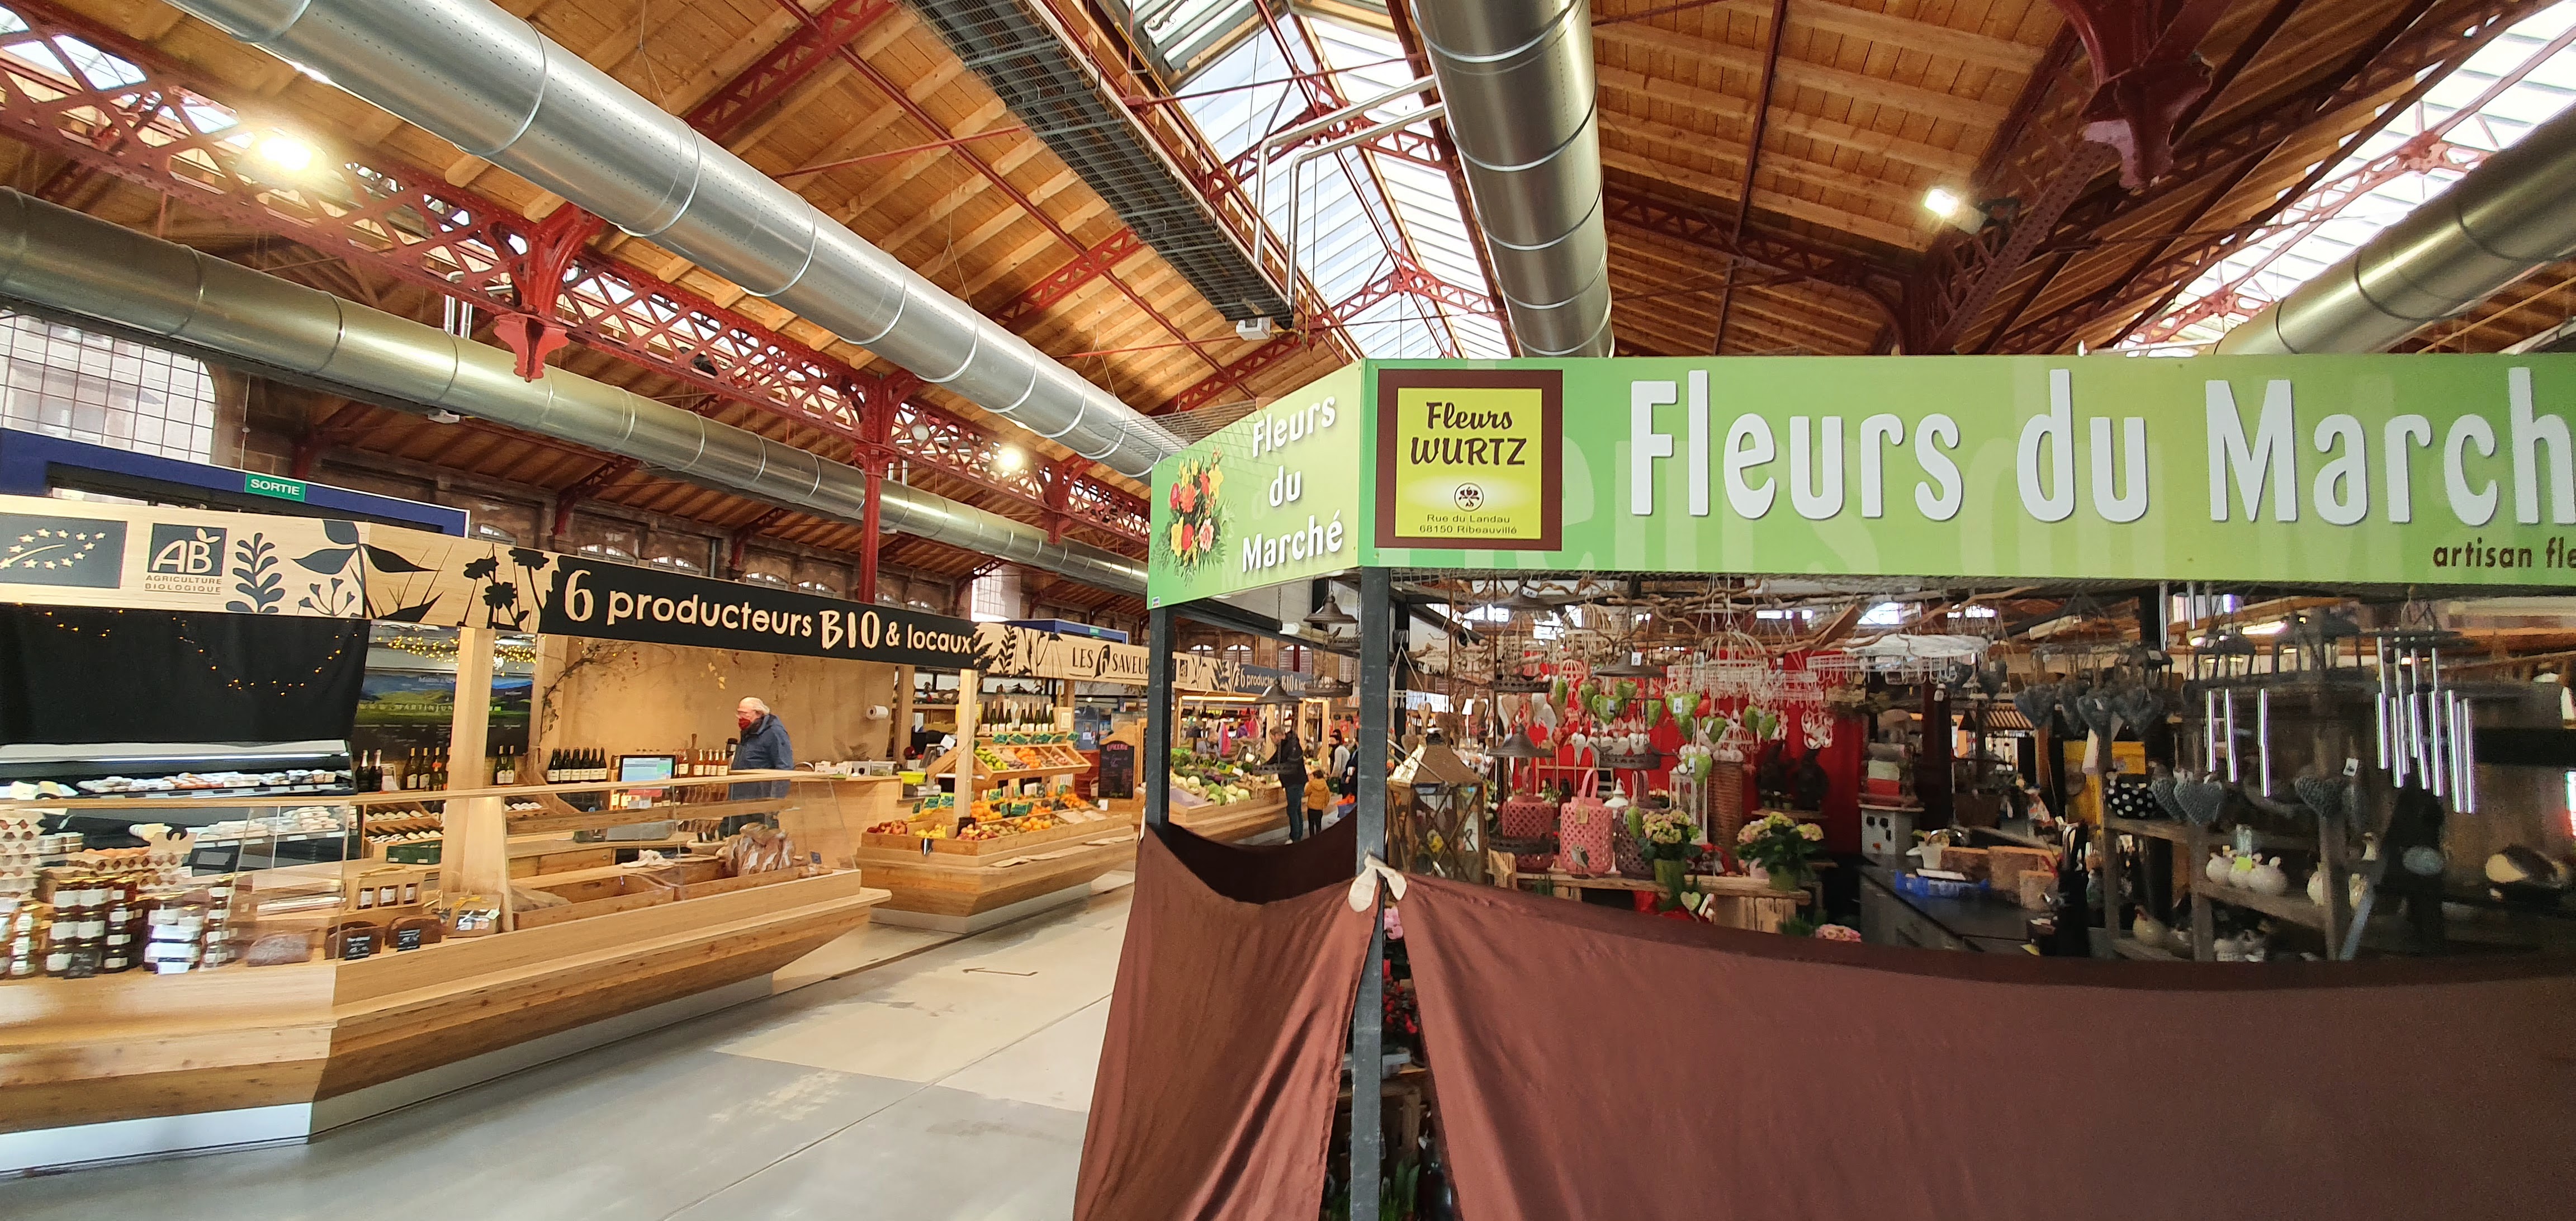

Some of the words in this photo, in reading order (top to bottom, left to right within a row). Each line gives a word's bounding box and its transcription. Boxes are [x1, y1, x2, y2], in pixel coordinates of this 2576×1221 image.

[1252, 395, 1337, 458] Fleurs
[1426, 401, 1513, 430] Fleurs
[1410, 437, 1527, 466] WURTZ
[1630, 368, 1963, 522] Fleurs
[2016, 368, 2148, 523] du
[2204, 366, 2576, 526] March
[250, 479, 300, 496] SORTIE
[1268, 465, 1302, 508] du
[1419, 524, 1453, 533] 68150
[1457, 525, 1517, 534] Ribeauvillé
[1427, 514, 1448, 523] Rue
[1452, 514, 1466, 523] du
[1470, 514, 1510, 523] Landau
[1242, 509, 1344, 573] Marché
[2432, 537, 2532, 568] artisan
[151, 539, 213, 574] AB
[145, 575, 222, 585] AGRICULTURE
[145, 583, 221, 593] BIOLOGIQUE
[564, 569, 594, 622] 6
[607, 590, 812, 638] producteurs
[818, 610, 880, 650] BIO
[886, 621, 901, 647] &
[907, 623, 973, 655] locaux
[1072, 646, 1093, 669] LES
[1240, 667, 1246, 688] 6
[1246, 673, 1275, 688] producte
